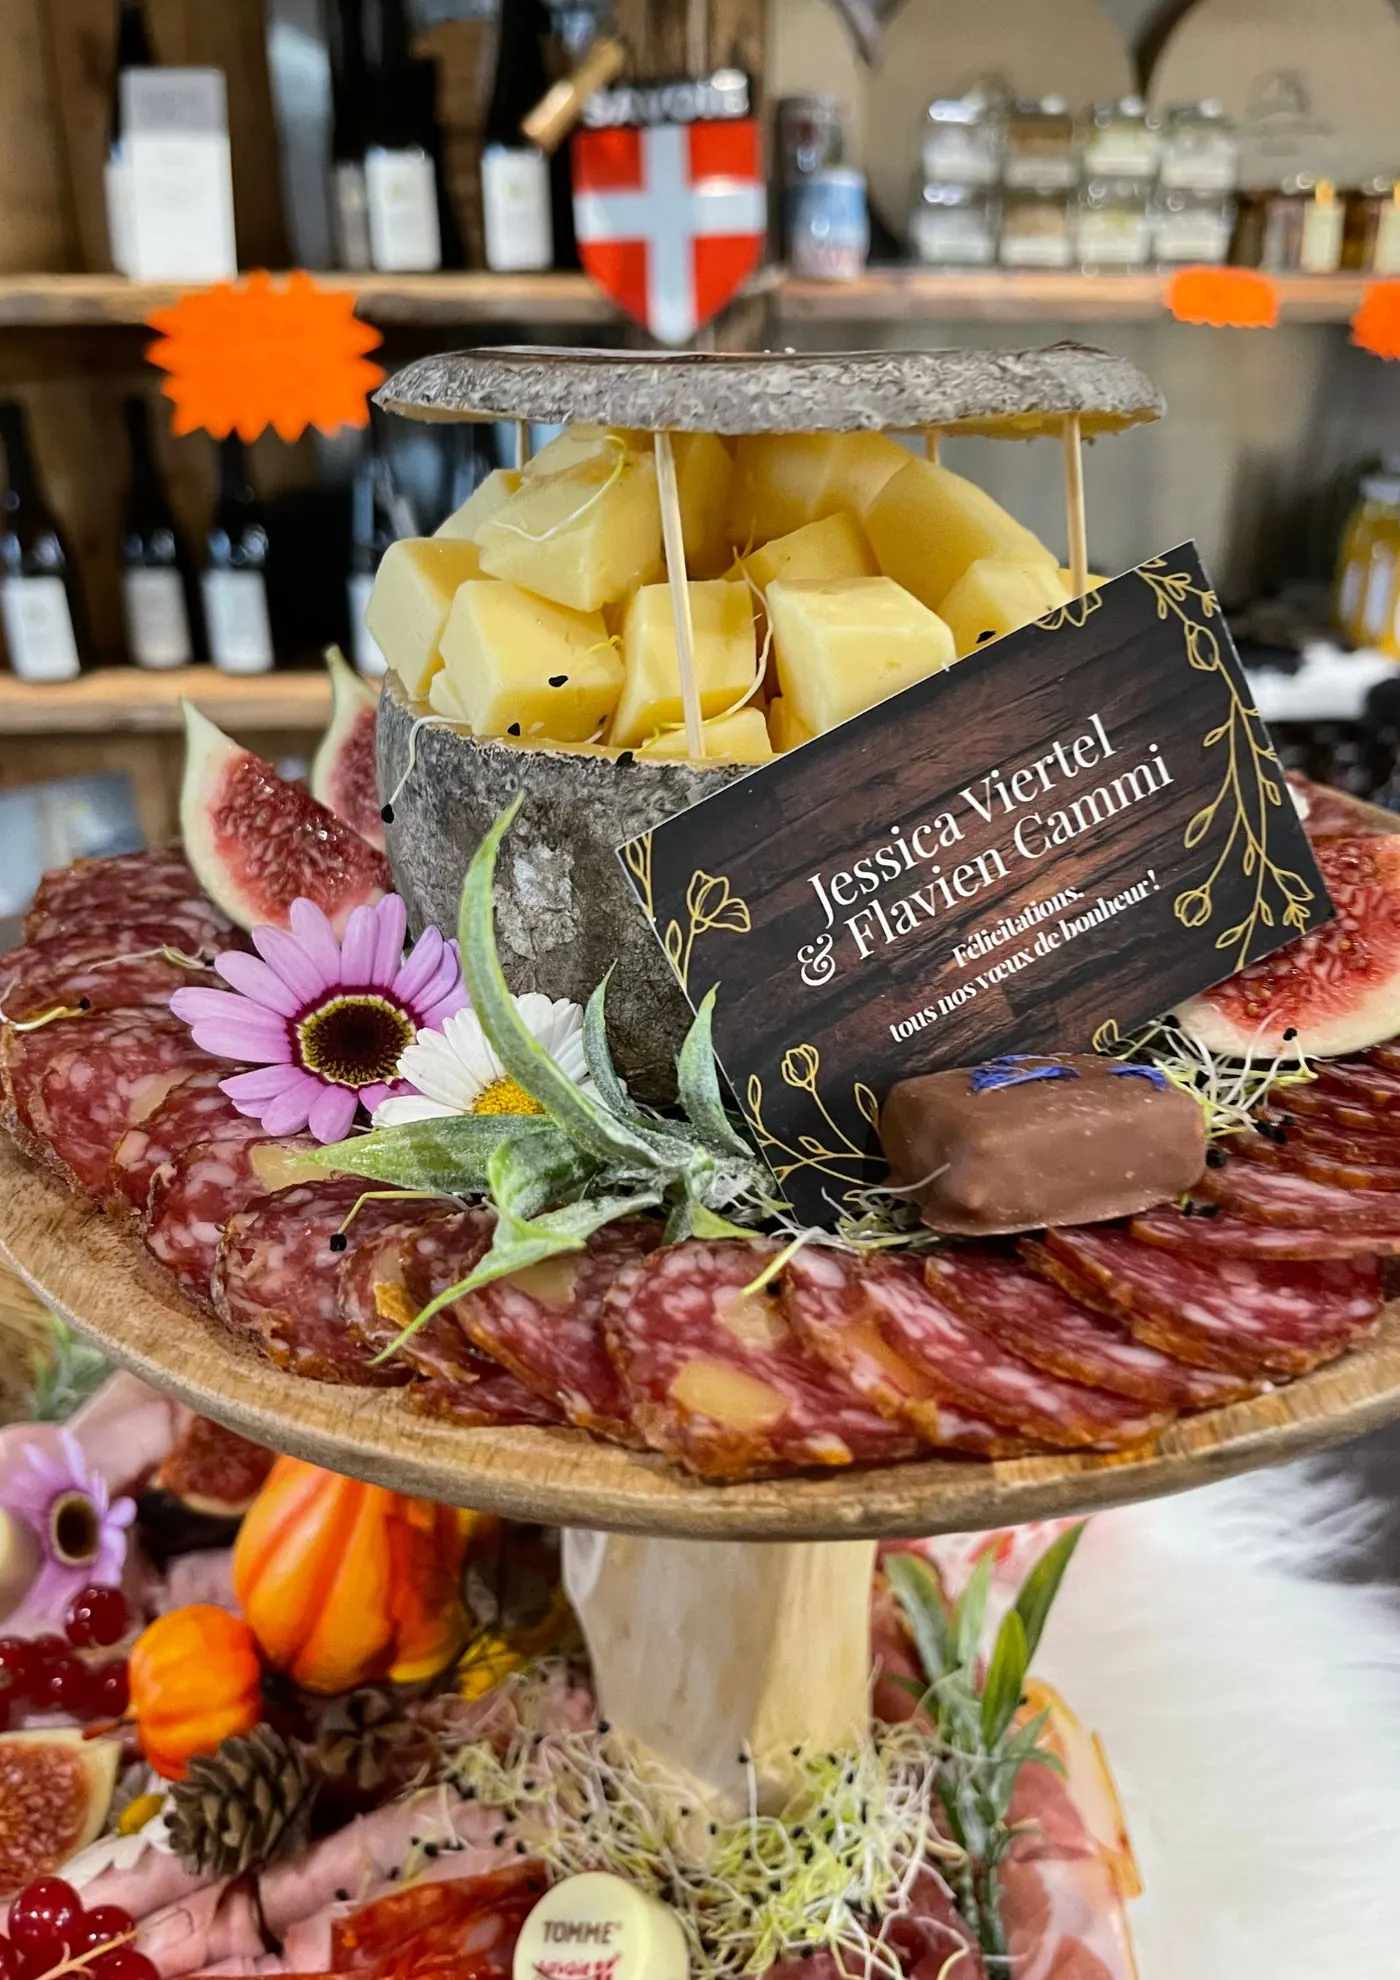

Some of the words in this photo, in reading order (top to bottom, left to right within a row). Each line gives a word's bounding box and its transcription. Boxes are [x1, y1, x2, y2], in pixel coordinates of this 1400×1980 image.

[797, 933, 836, 987] &
[842, 848, 1012, 960] Flavien
[1013, 743, 1175, 859] Cammi
[806, 812, 966, 930] Jessica
[958, 713, 1117, 823] Viertel
[889, 1005, 938, 1043] tous
[936, 981, 978, 1016] nos
[974, 947, 1036, 990] vœux
[1033, 932, 1062, 958] de
[542, 1920, 616, 1945] TOMME
